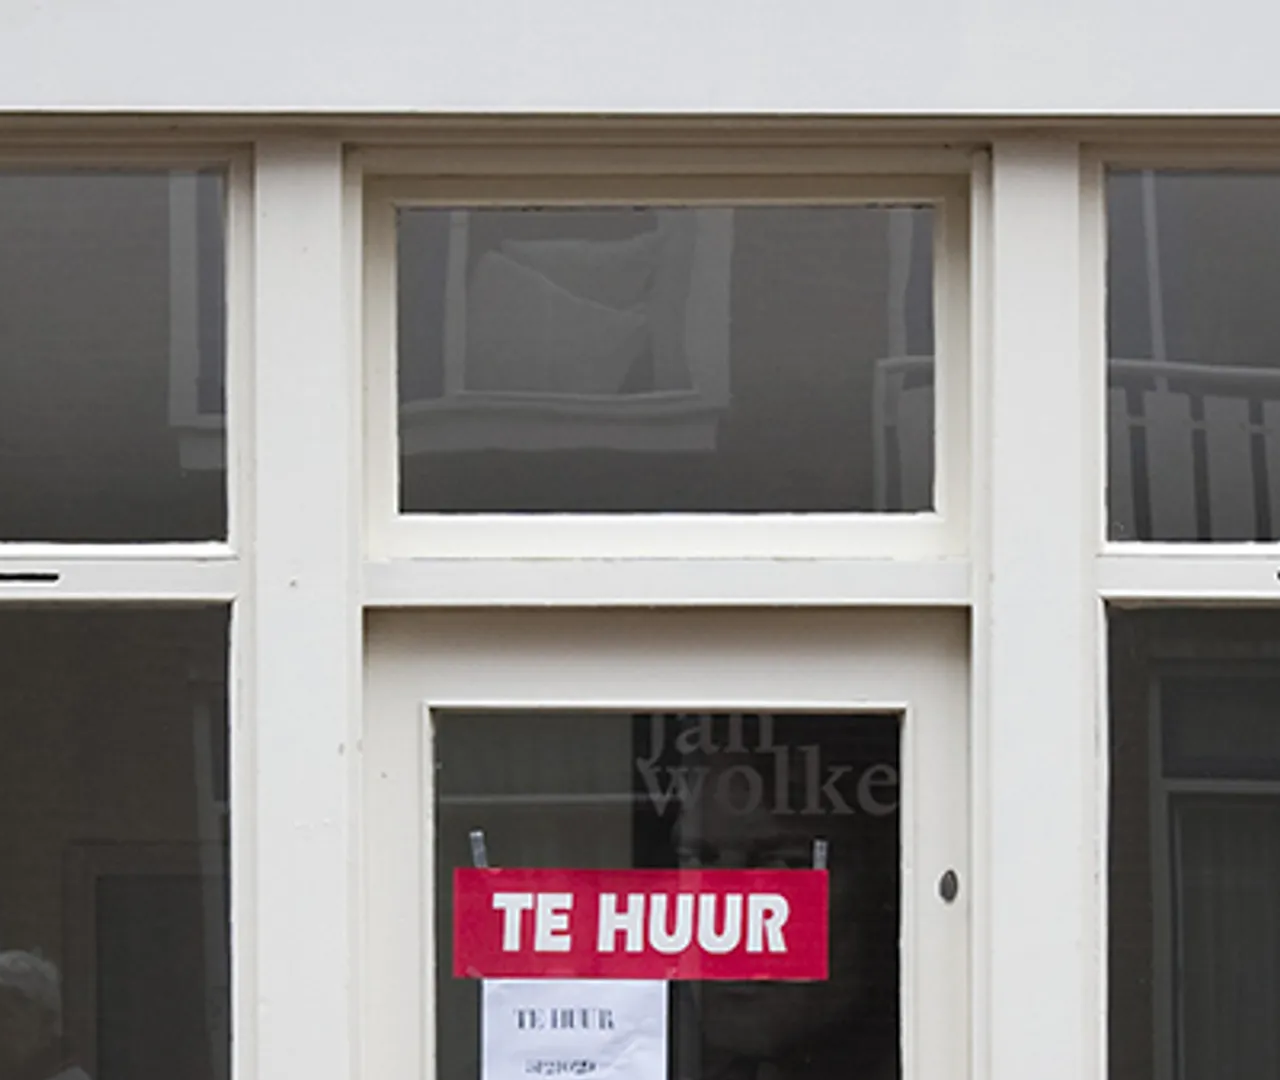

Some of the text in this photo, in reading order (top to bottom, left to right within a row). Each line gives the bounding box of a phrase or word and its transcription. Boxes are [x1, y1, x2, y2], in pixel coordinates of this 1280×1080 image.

[492, 892, 789, 954] TE HUUR
[513, 1008, 545, 1029] TE
